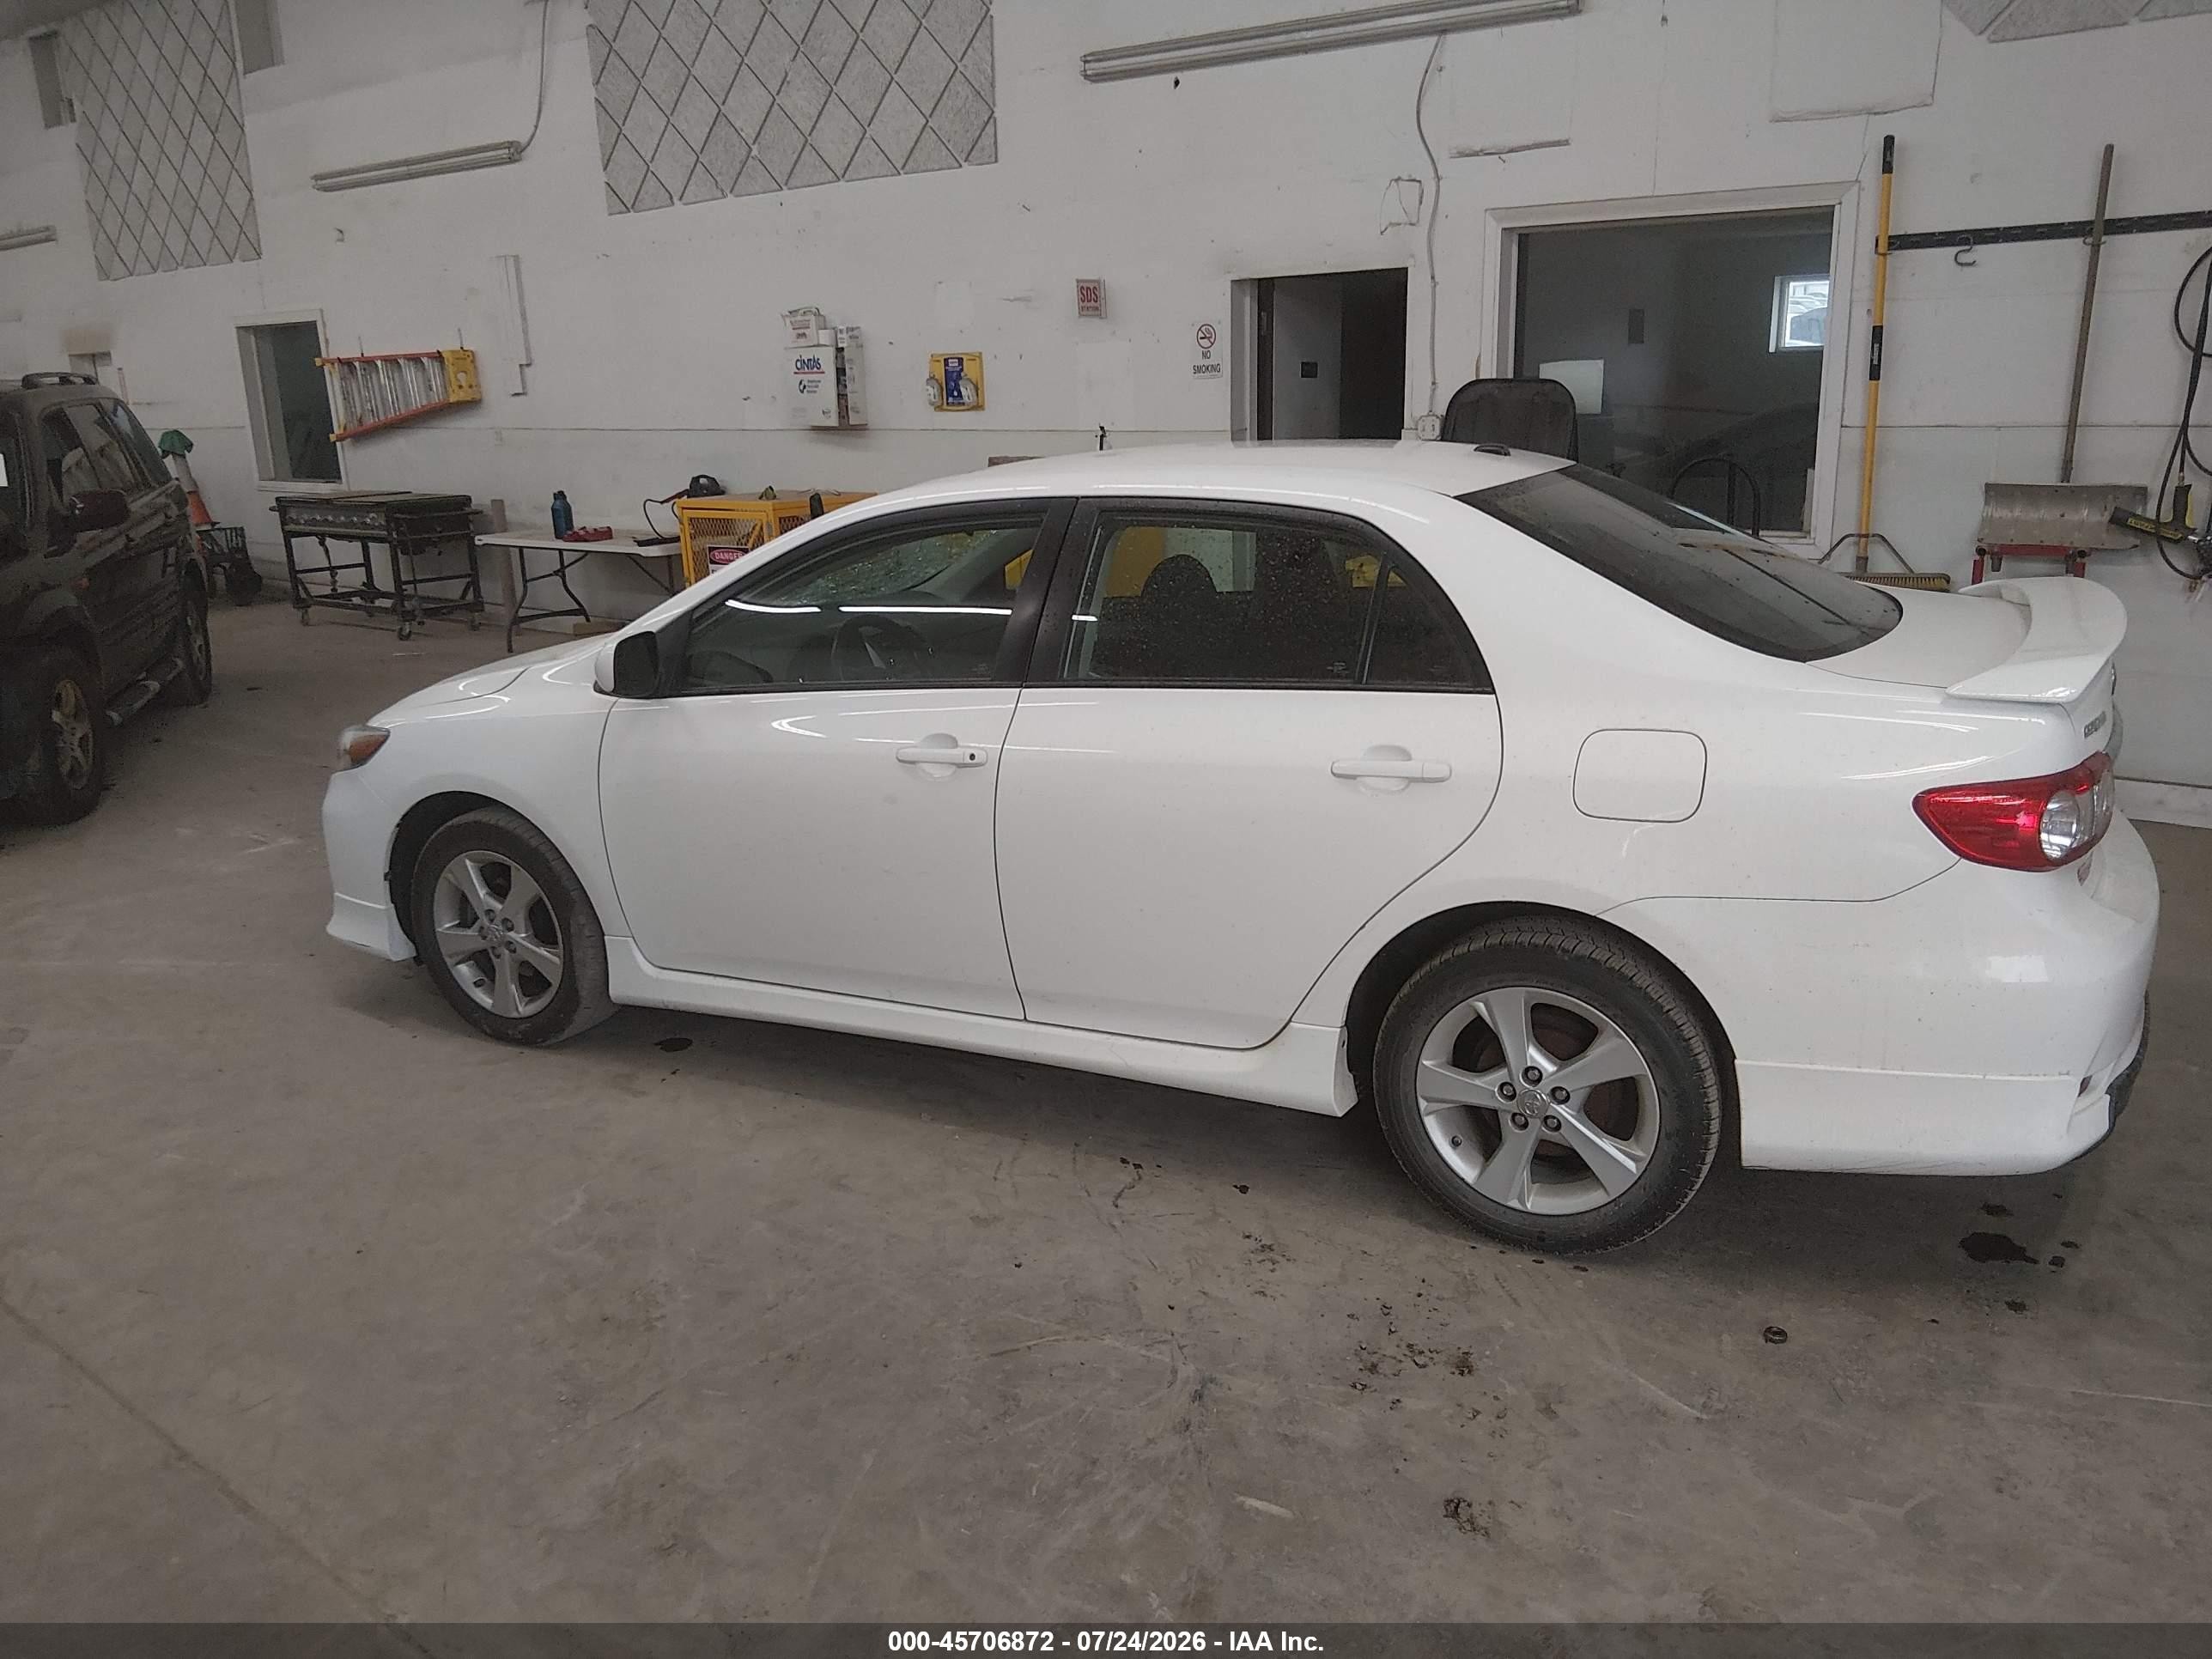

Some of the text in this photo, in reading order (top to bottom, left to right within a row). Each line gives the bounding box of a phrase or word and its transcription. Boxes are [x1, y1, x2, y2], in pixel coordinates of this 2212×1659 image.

[1079, 285, 1098, 303] SDS
[1201, 349, 1212, 360] NO
[1193, 363, 1221, 374] SMOKING
